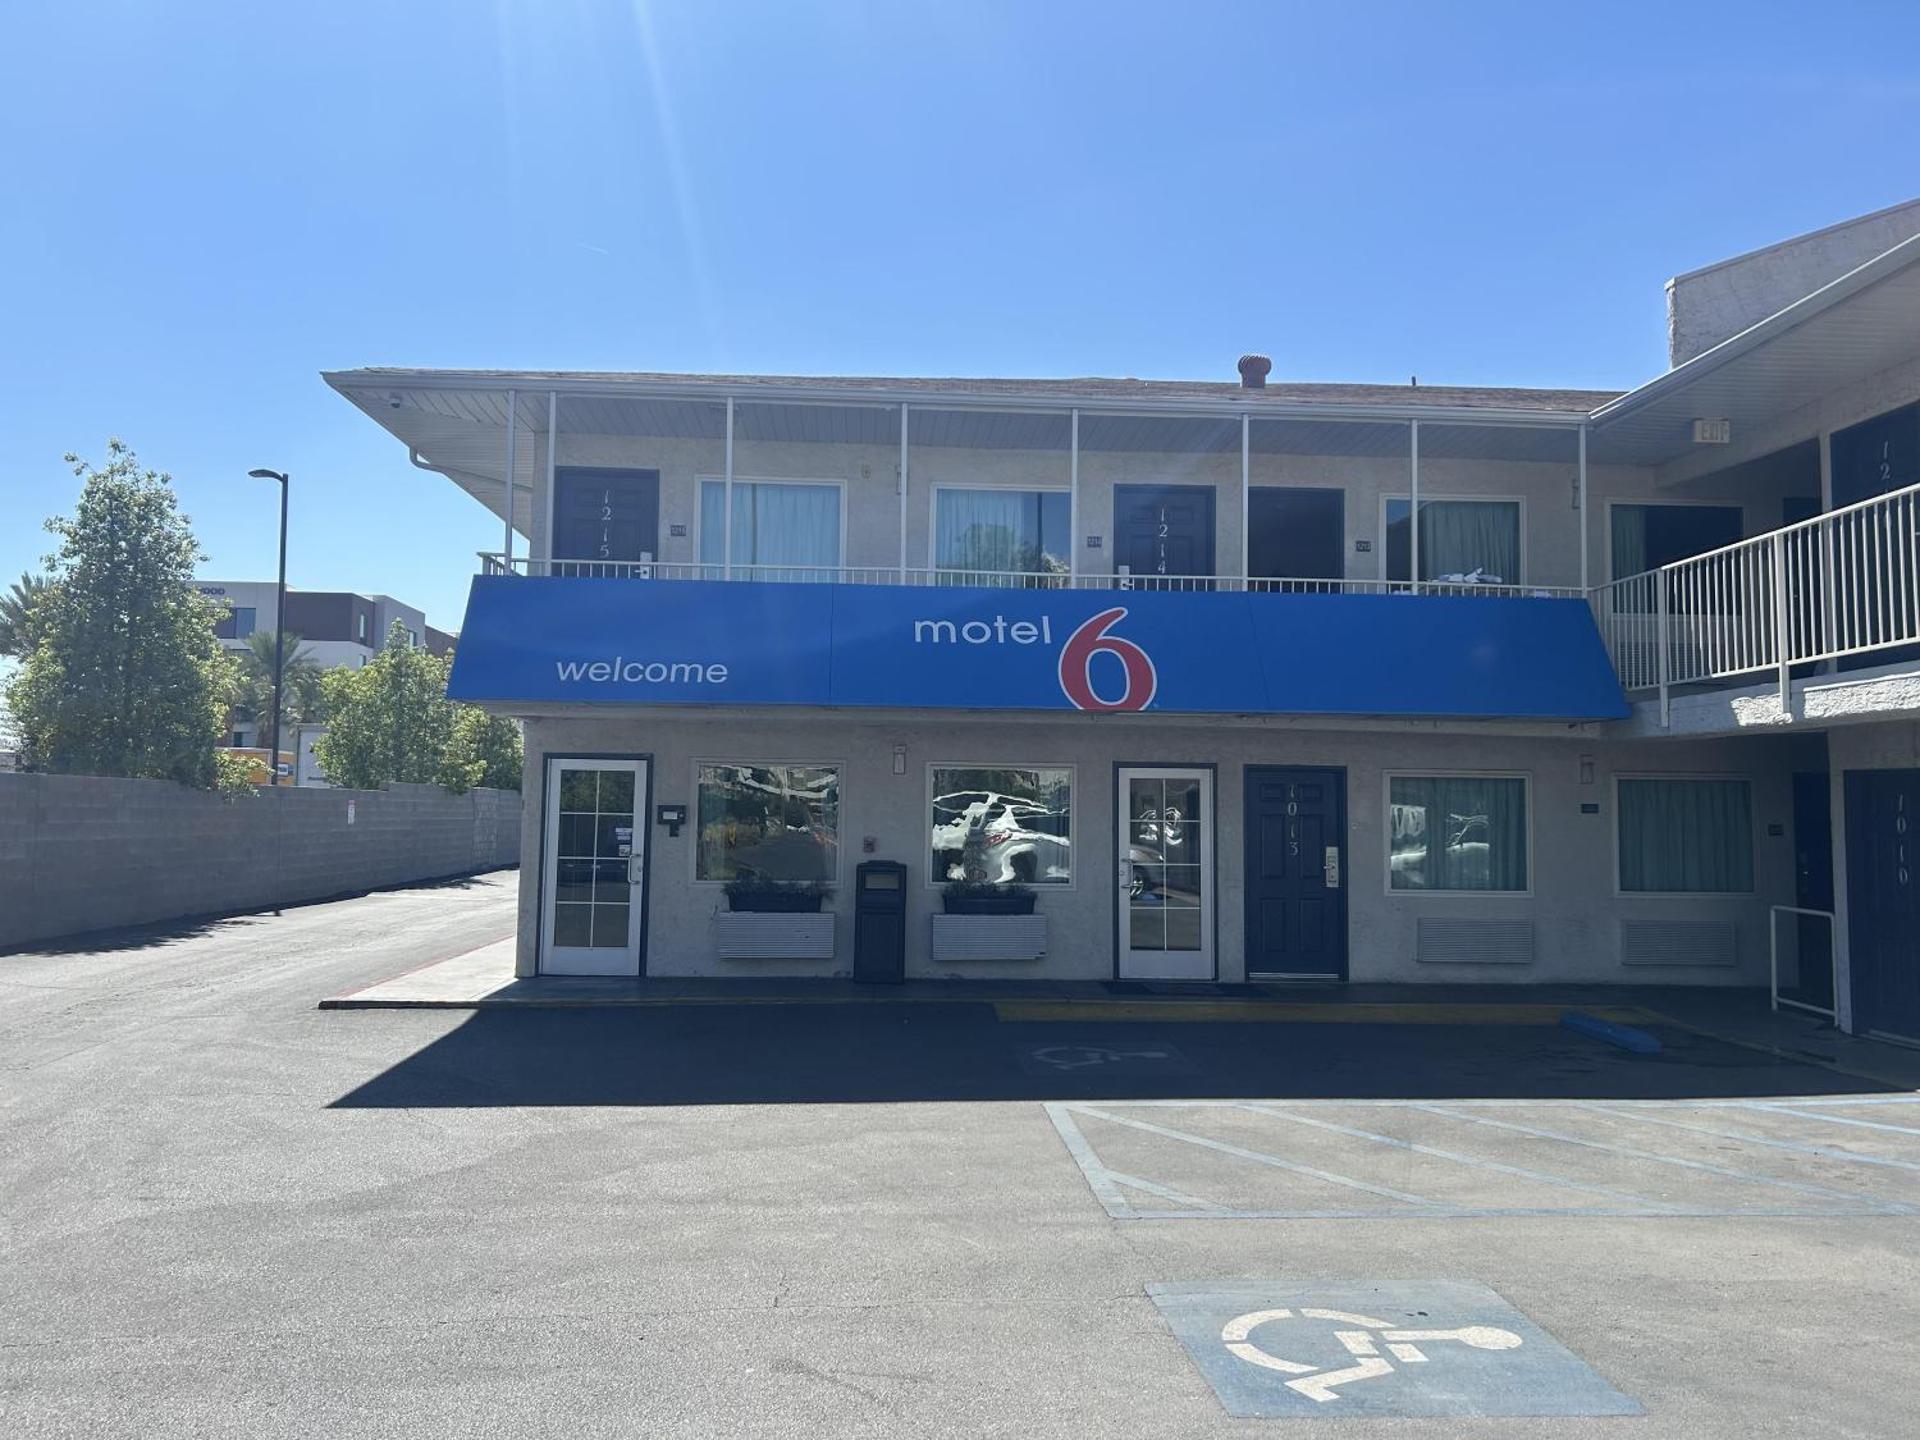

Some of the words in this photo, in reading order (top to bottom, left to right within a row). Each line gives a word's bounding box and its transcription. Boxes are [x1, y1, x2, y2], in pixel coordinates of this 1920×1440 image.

[600, 490, 612, 559] 1215
[1157, 507, 1169, 575] 1214
[556, 656, 728, 684] welcome
[914, 615, 1052, 644] motel
[1058, 607, 1157, 712] 6
[1287, 783, 1299, 856] 1013
